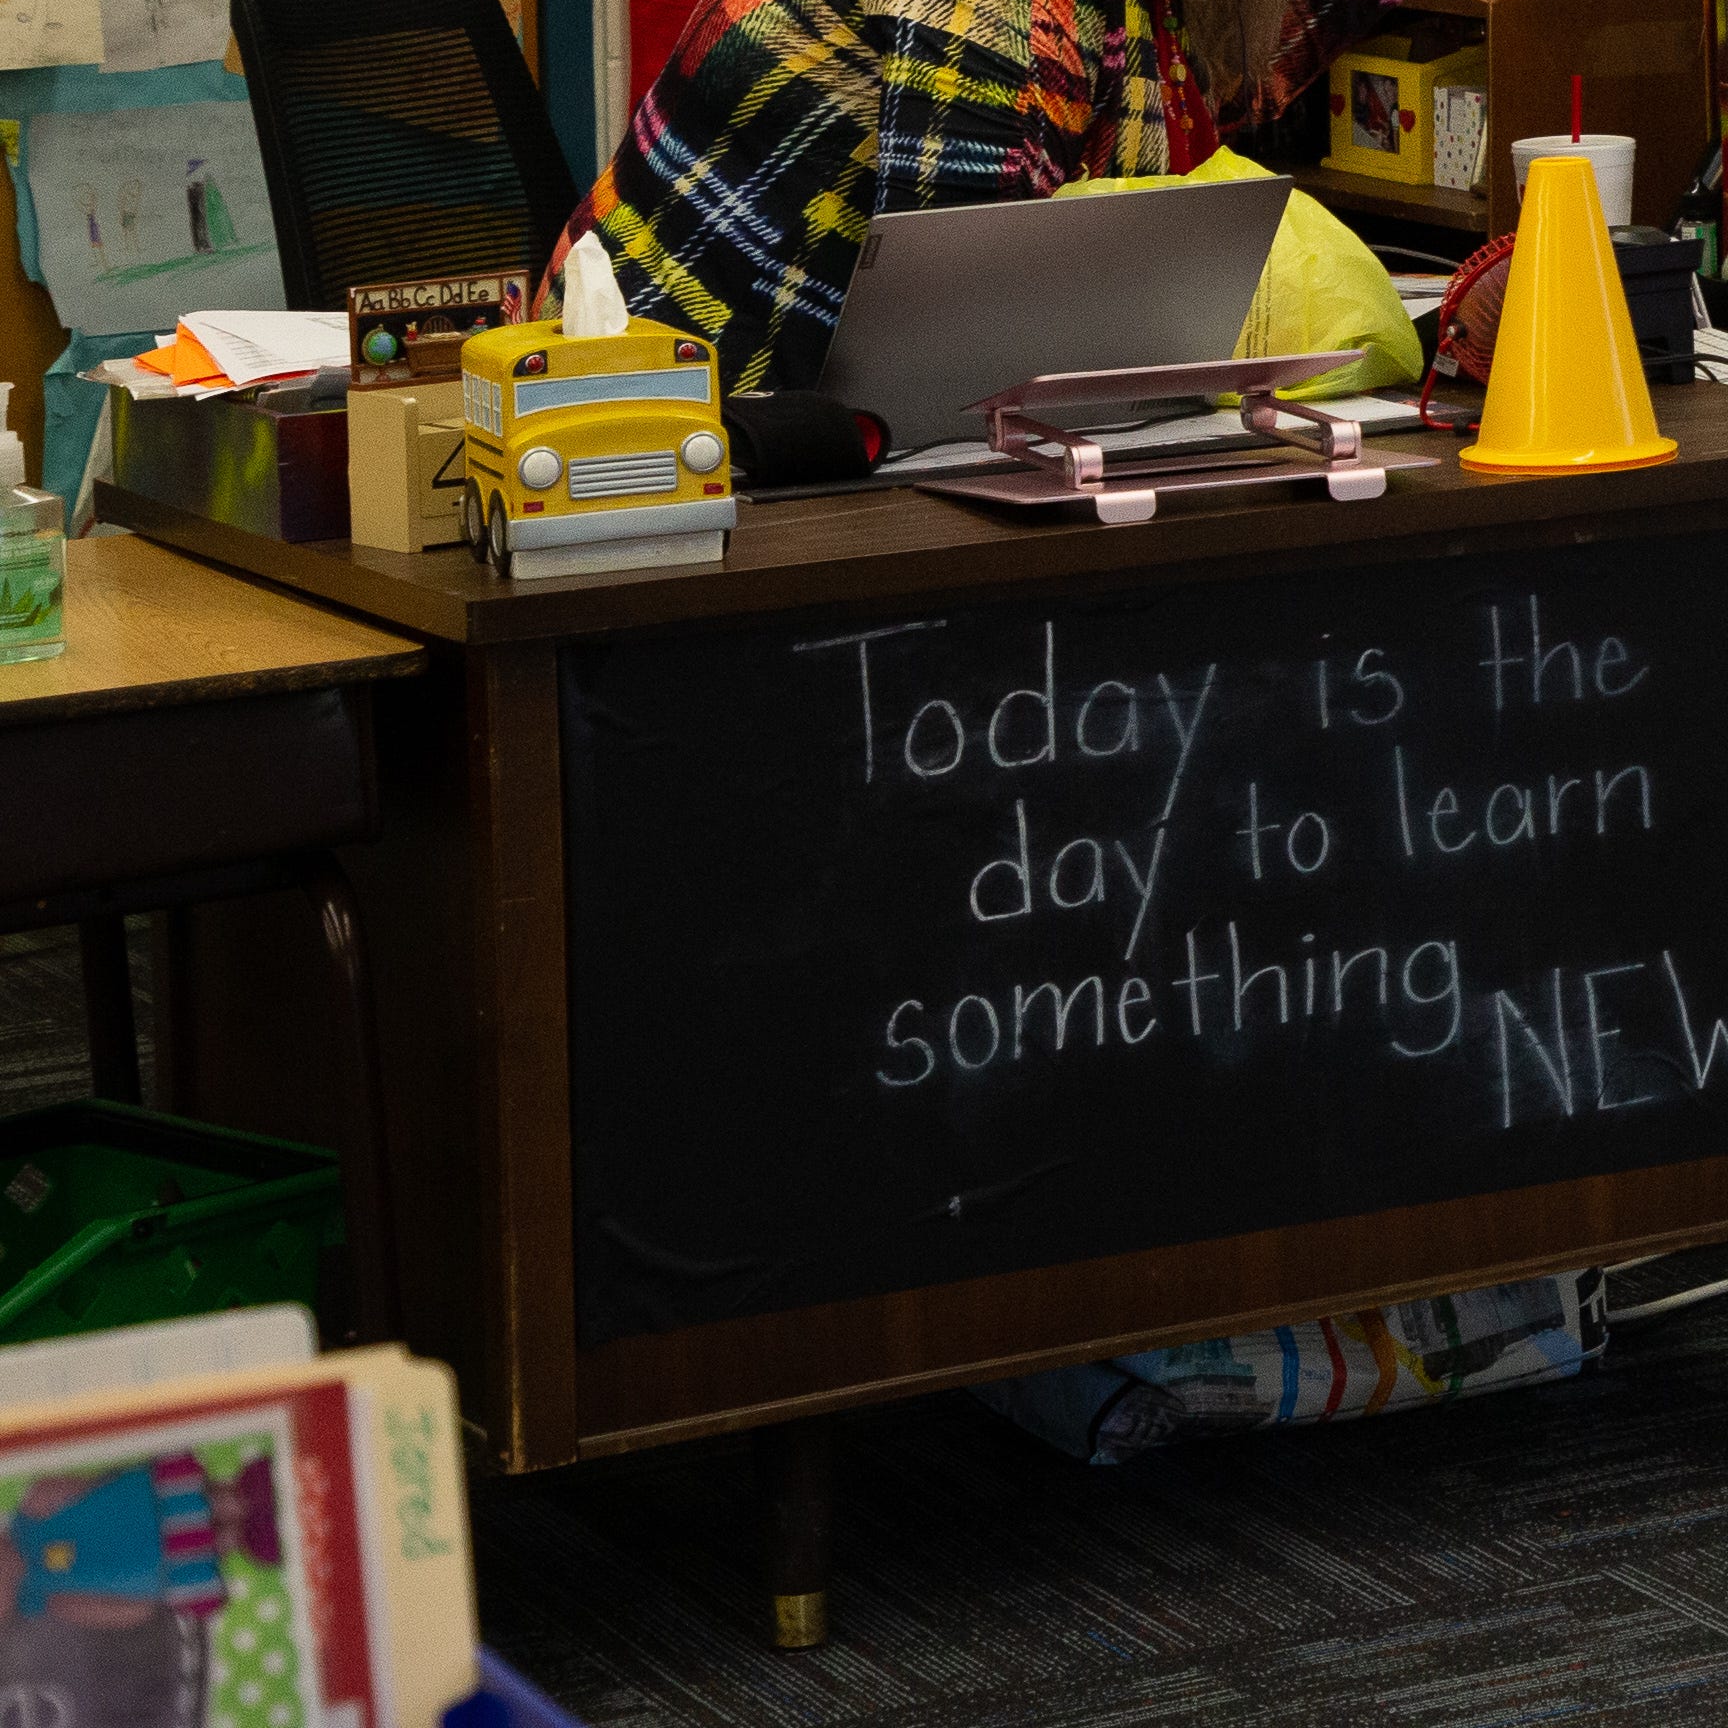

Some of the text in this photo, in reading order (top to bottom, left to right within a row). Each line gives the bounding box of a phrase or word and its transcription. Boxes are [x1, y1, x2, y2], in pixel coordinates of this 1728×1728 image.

[359, 280, 490, 311] Aa Bb Cc Dd Ee
[793, 593, 1650, 822] Today is the
[969, 746, 1651, 961] day to learn
[875, 920, 1462, 1088] something
